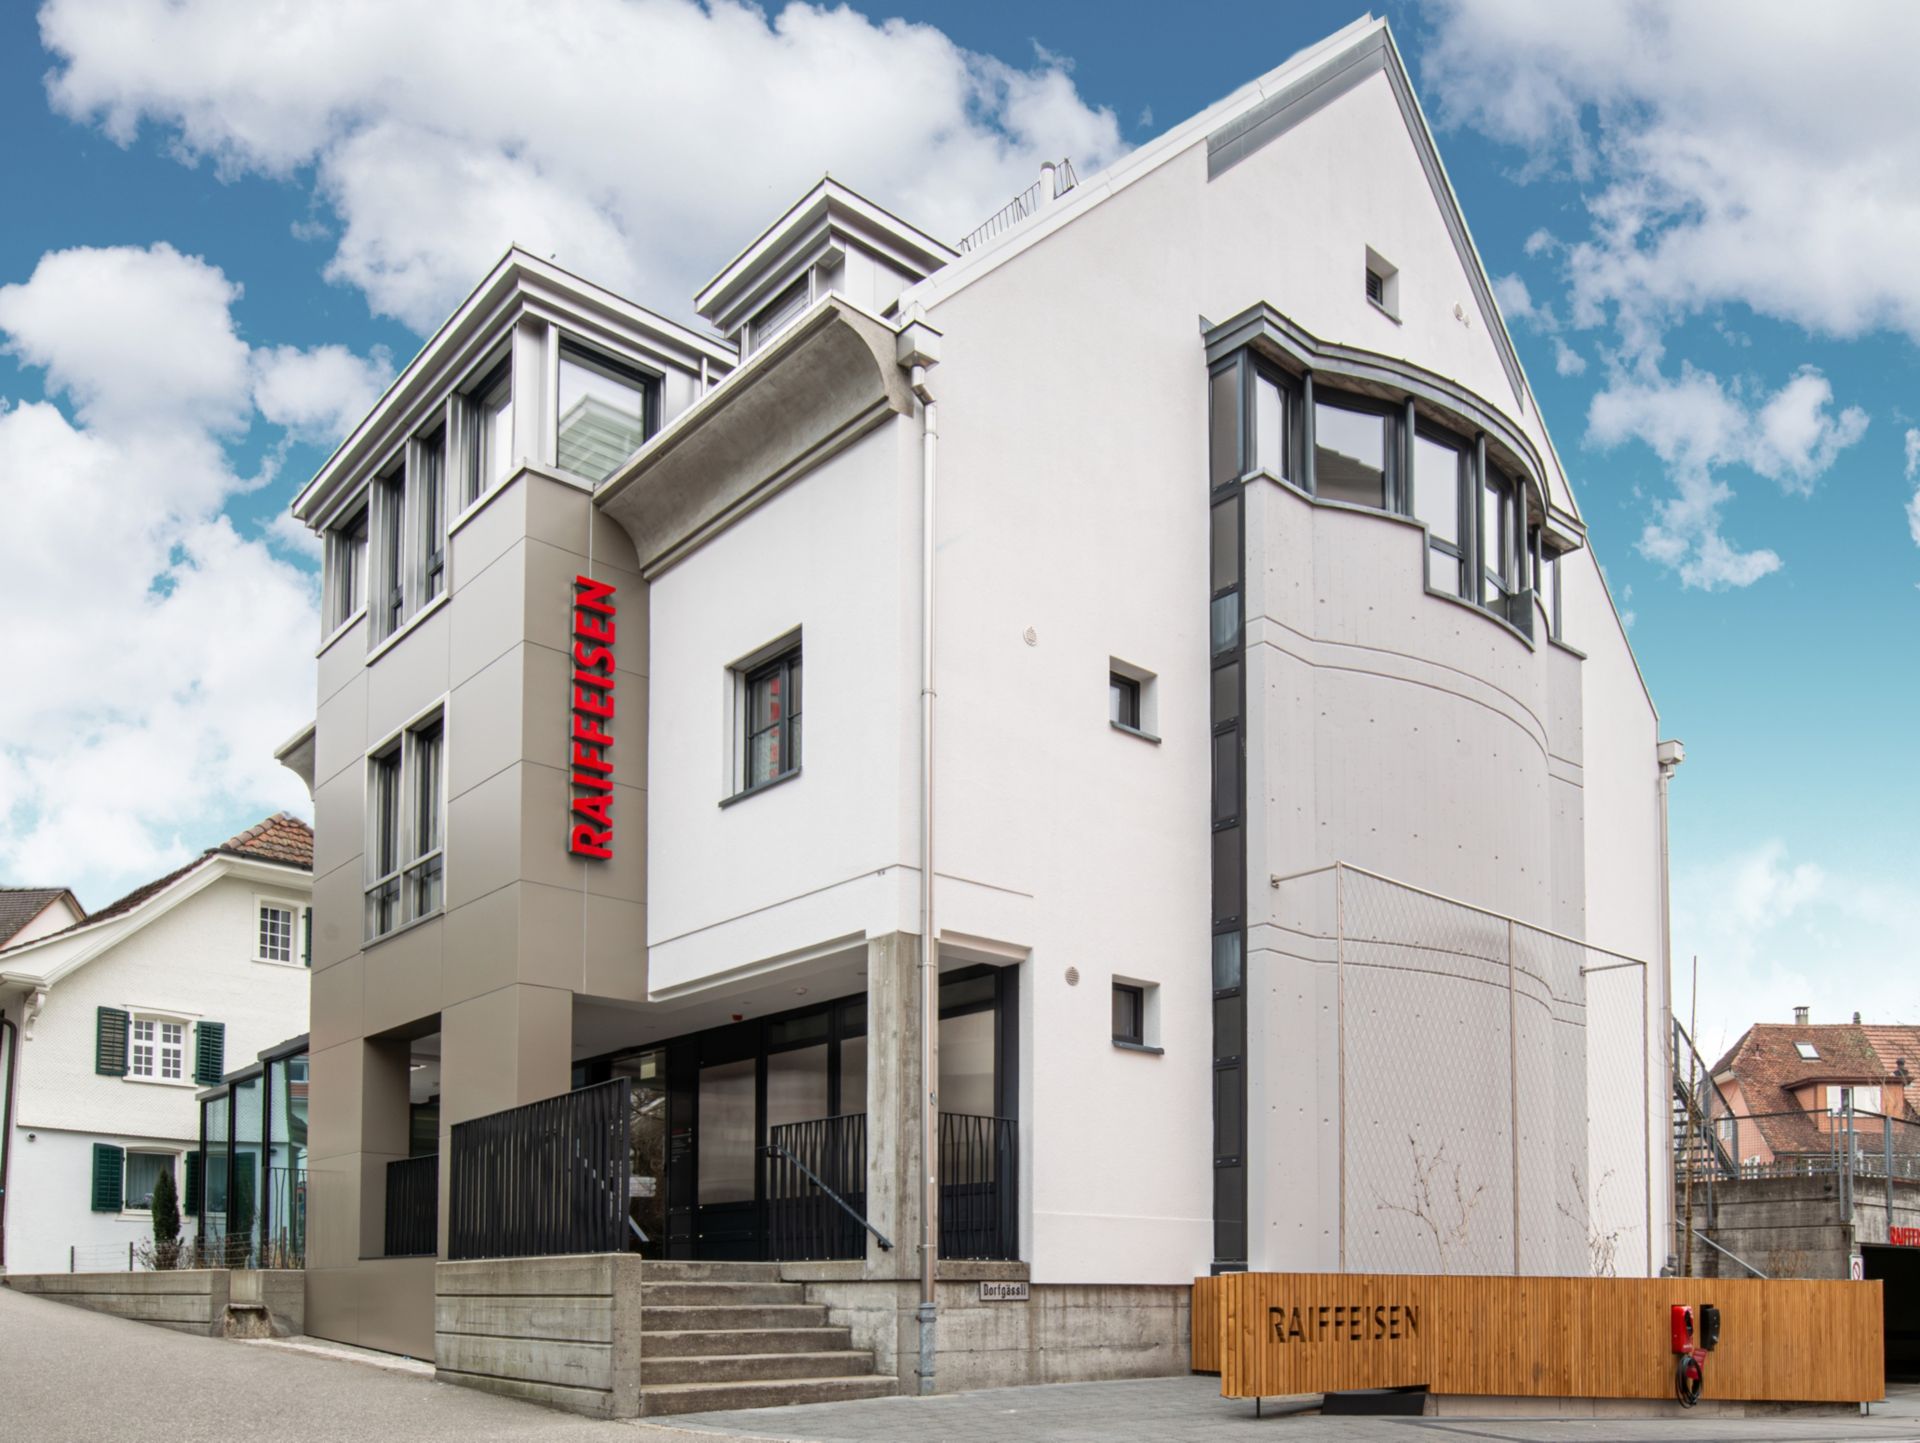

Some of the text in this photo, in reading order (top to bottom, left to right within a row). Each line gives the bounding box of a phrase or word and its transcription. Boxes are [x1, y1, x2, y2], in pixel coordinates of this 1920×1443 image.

[571, 575, 616, 860] RAIFFEISEN
[983, 1283, 1026, 1298] Dorfgässli
[1269, 1305, 1419, 1344] RAIFFEISEN
